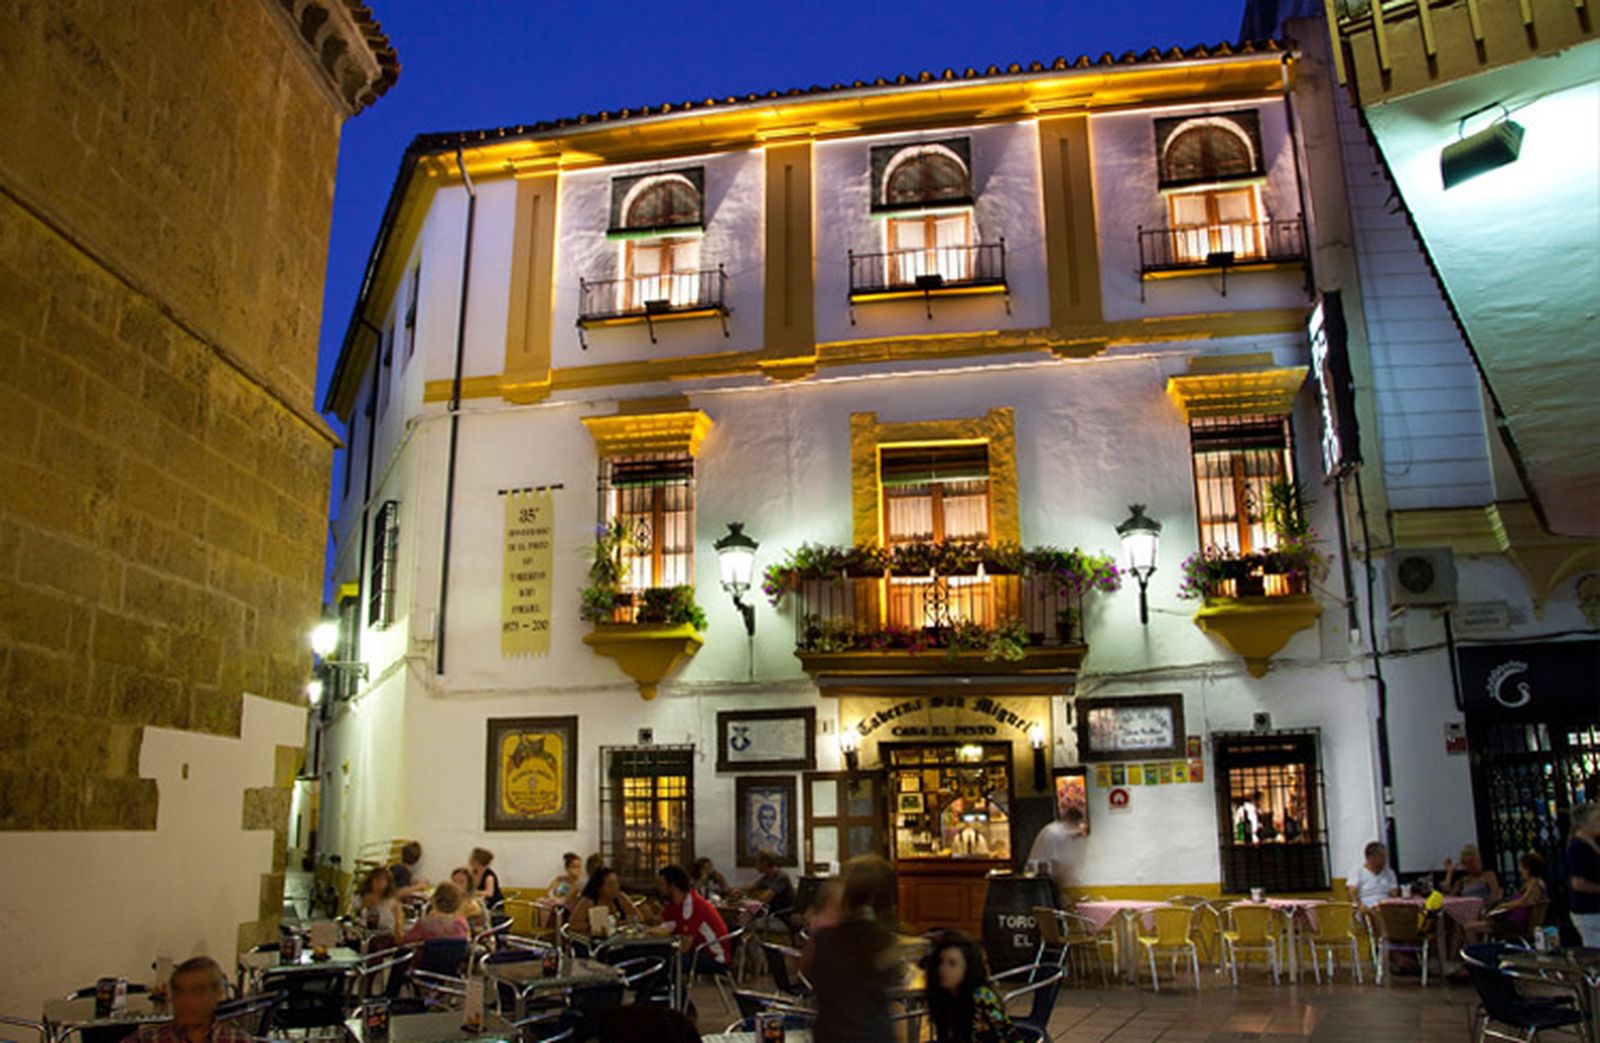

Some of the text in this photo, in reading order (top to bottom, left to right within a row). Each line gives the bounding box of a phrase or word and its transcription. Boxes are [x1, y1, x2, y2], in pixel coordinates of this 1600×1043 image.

[856, 696, 1033, 737] Taberna San Miguel
[891, 725, 997, 738] CASA EL PINTO
[997, 914, 1037, 929] TORO
[1013, 934, 1034, 947] EL
